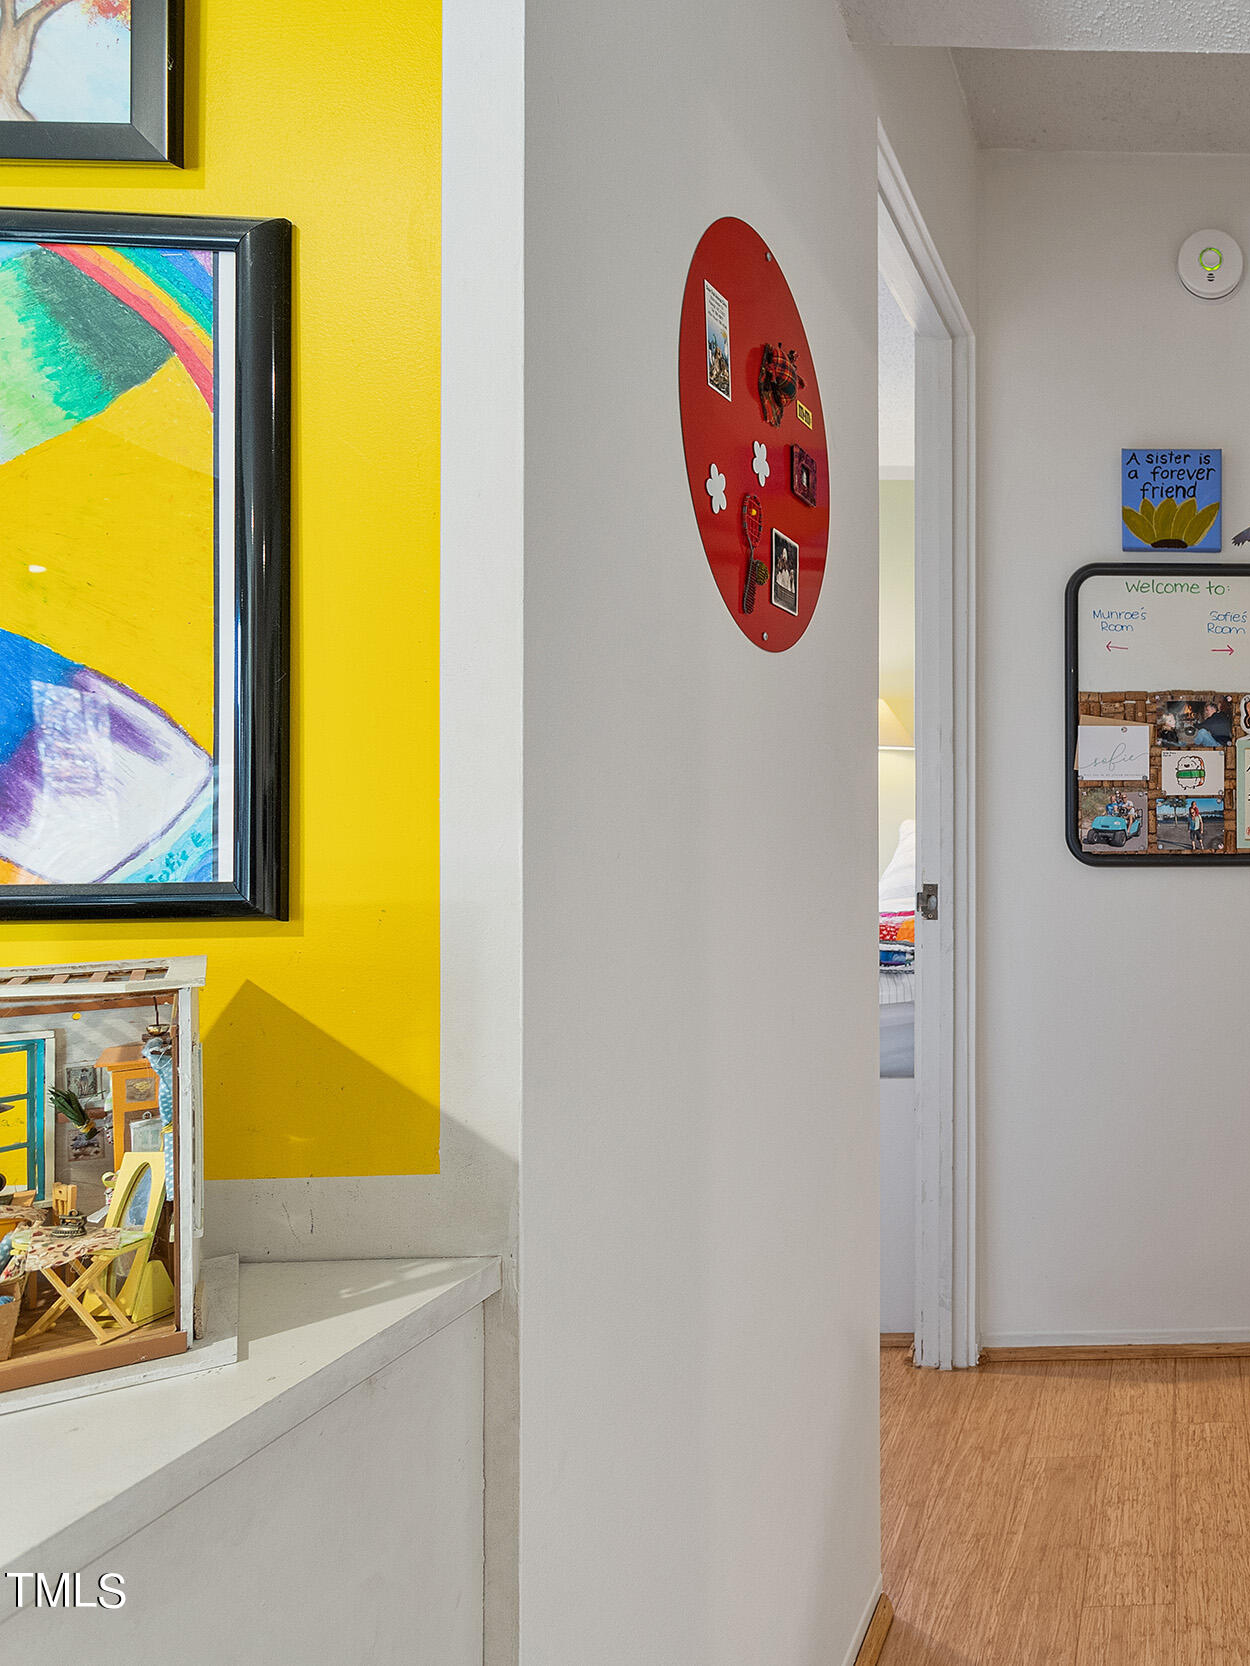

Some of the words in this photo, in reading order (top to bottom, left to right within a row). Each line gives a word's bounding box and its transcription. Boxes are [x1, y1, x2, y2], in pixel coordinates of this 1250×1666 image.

[1126, 451, 1141, 466] A
[1145, 451, 1191, 466] sister
[1199, 452, 1211, 465] is
[1127, 468, 1139, 480] a
[1150, 465, 1216, 481] forever
[1140, 481, 1198, 500] friend
[1125, 579, 1201, 595] Welcome
[1205, 580, 1231, 596] to:
[1092, 606, 1147, 621] Munroe's
[1209, 610, 1248, 624] Sofie's
[1101, 620, 1134, 633] Room
[1207, 622, 1247, 635] Room
[1079, 742, 1149, 771] sofie
